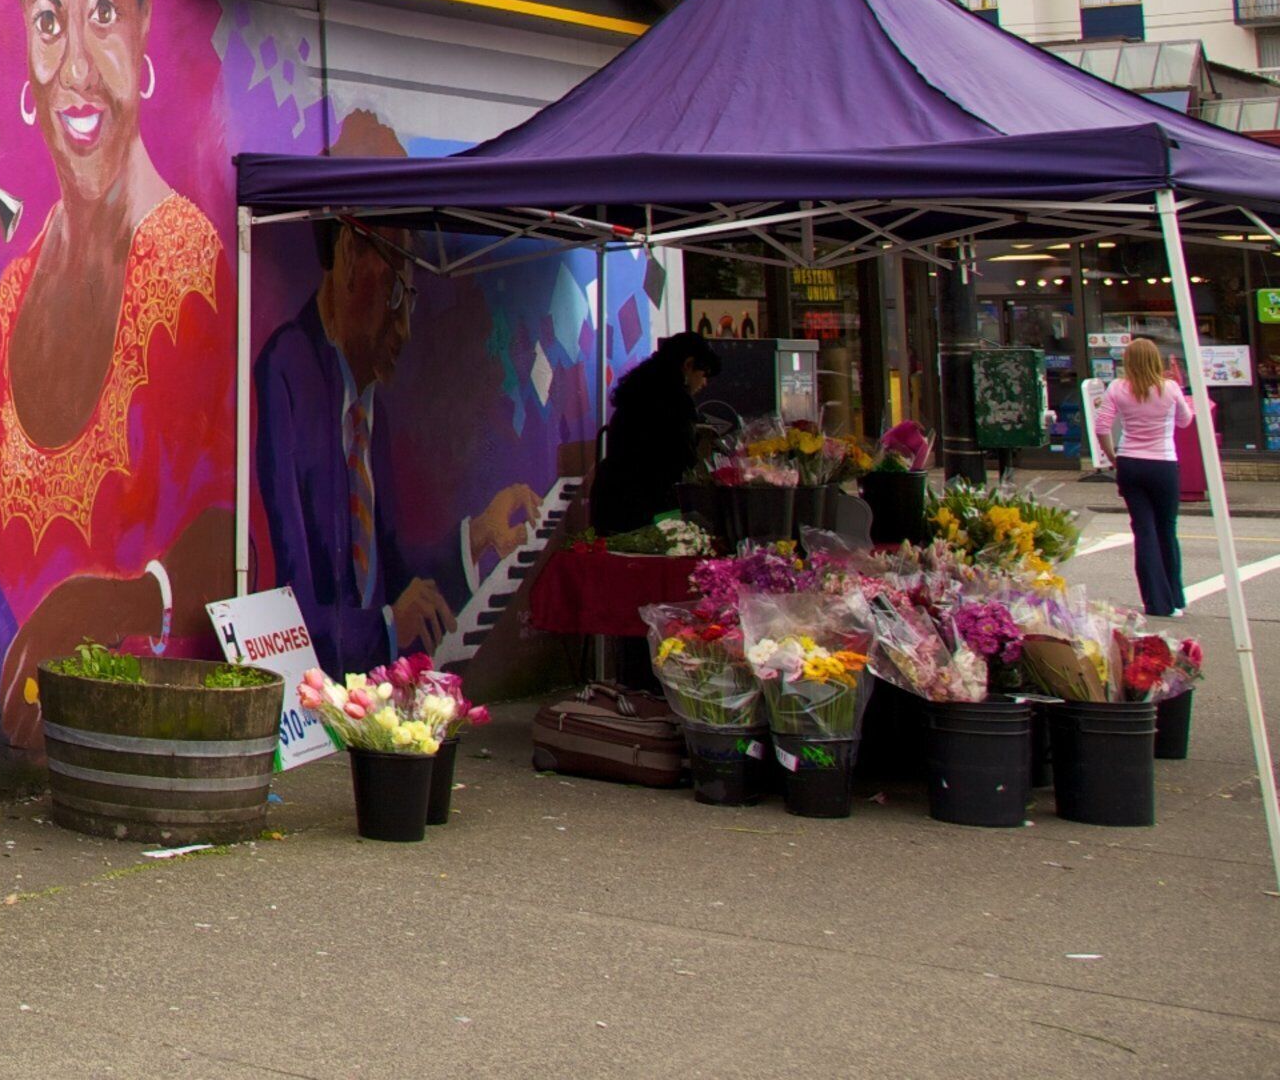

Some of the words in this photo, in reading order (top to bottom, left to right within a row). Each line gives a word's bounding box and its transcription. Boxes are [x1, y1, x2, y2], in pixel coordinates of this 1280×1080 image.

[793, 266, 835, 285] WESTERN
[807, 286, 837, 301] UNION
[245, 625, 310, 661] BUNCHES
